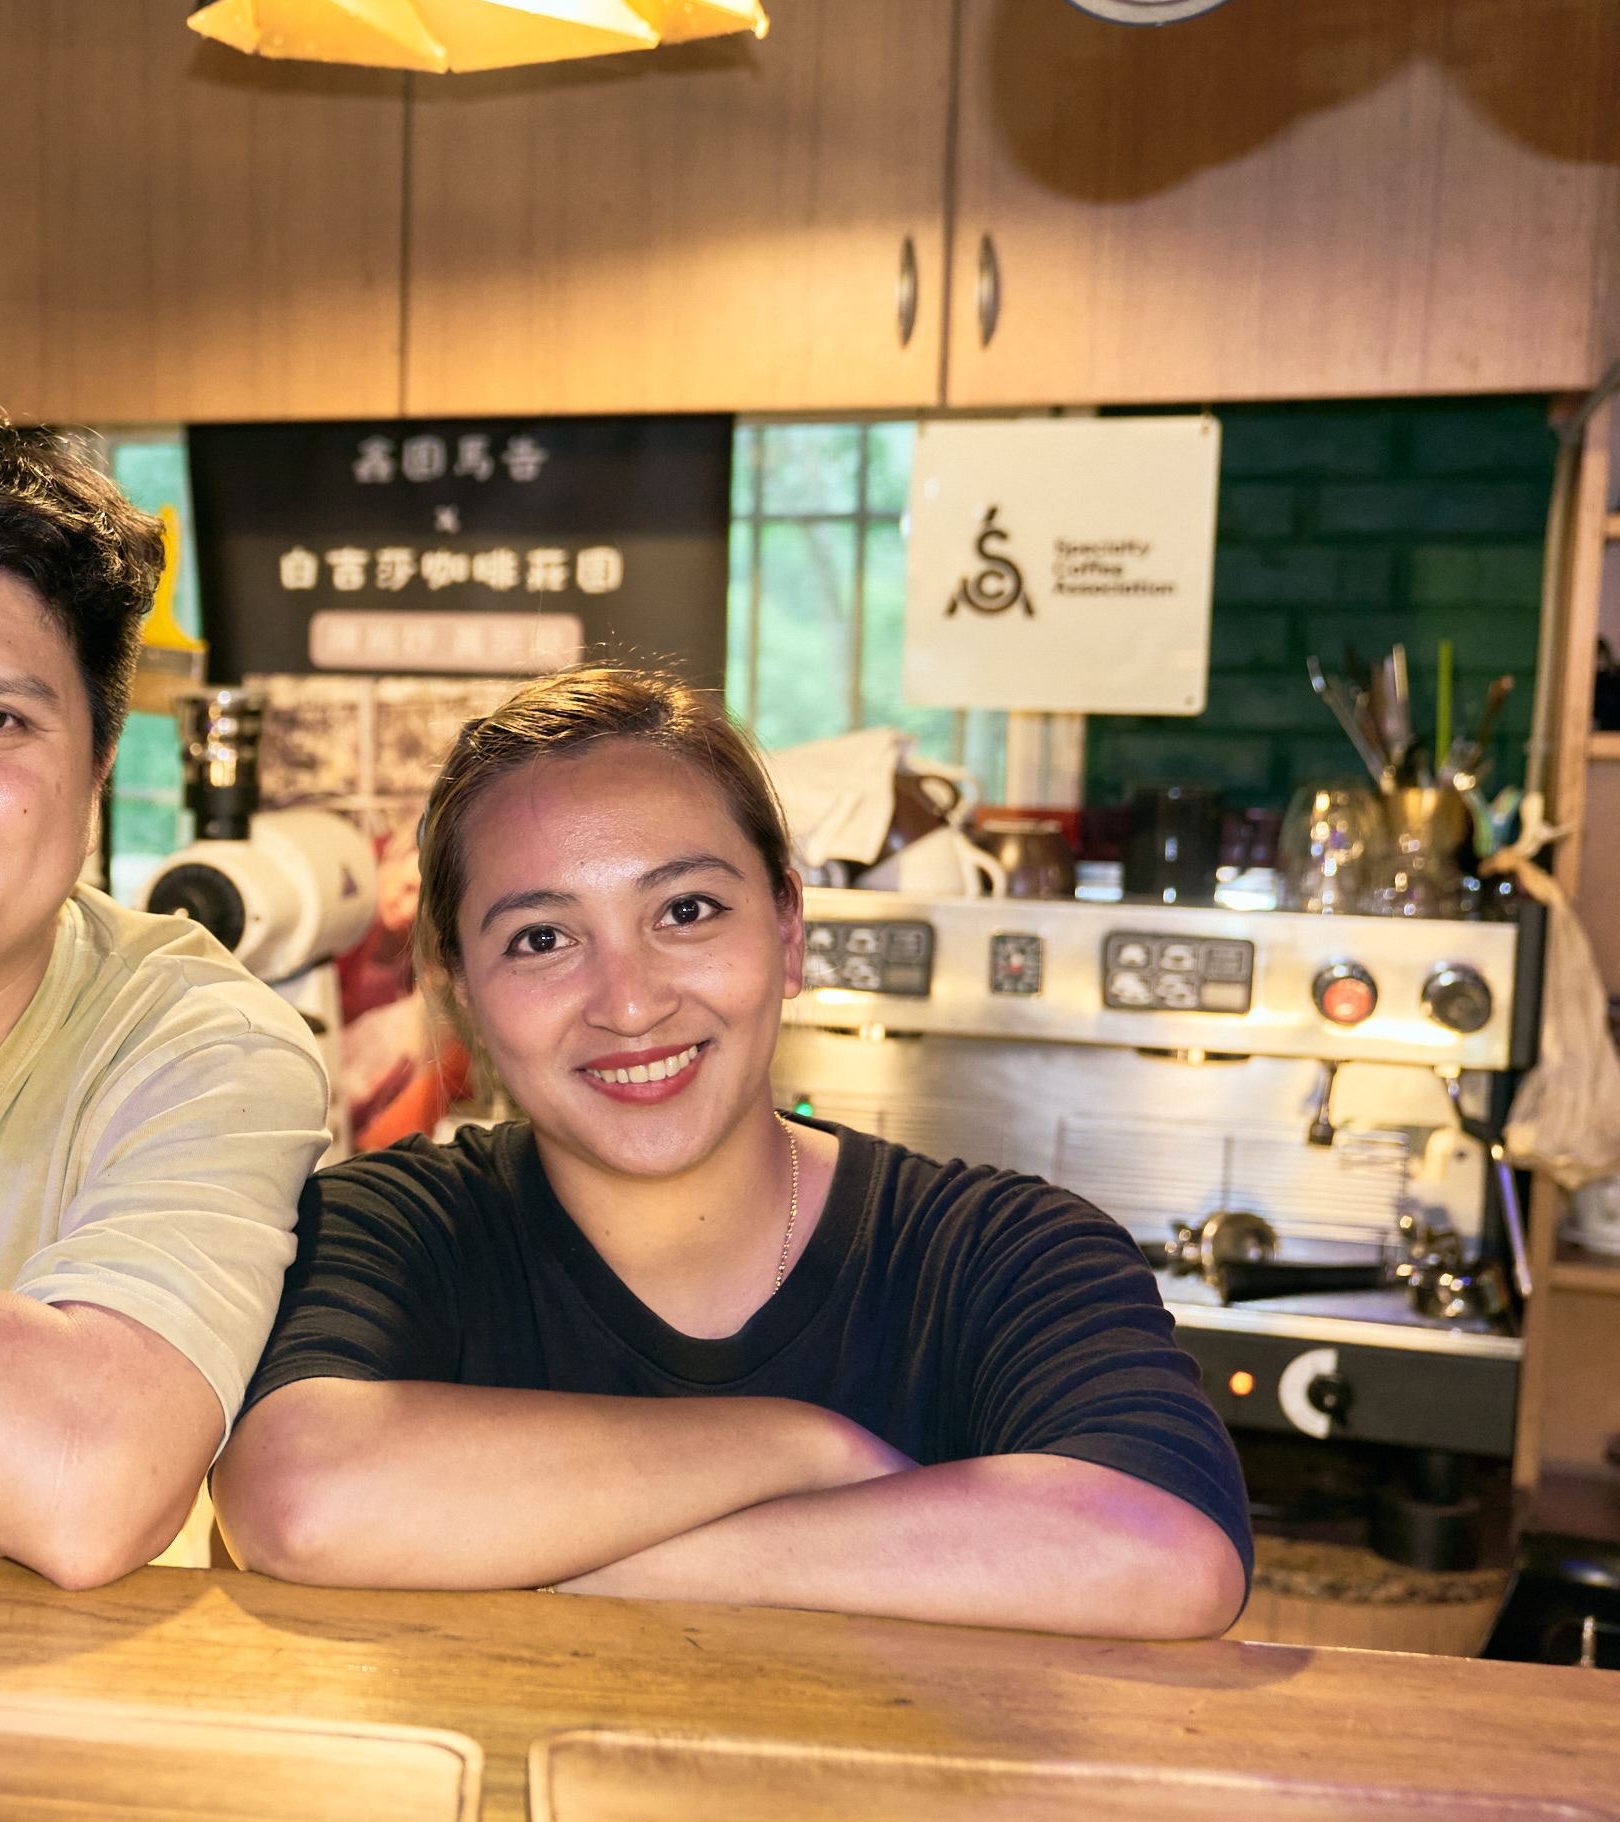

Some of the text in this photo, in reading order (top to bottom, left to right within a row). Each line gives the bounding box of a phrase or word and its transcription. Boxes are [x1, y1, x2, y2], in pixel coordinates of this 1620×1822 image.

[1053, 540, 1150, 558] Specialty
[1053, 560, 1123, 577] Coffee
[1053, 581, 1176, 597] Association
